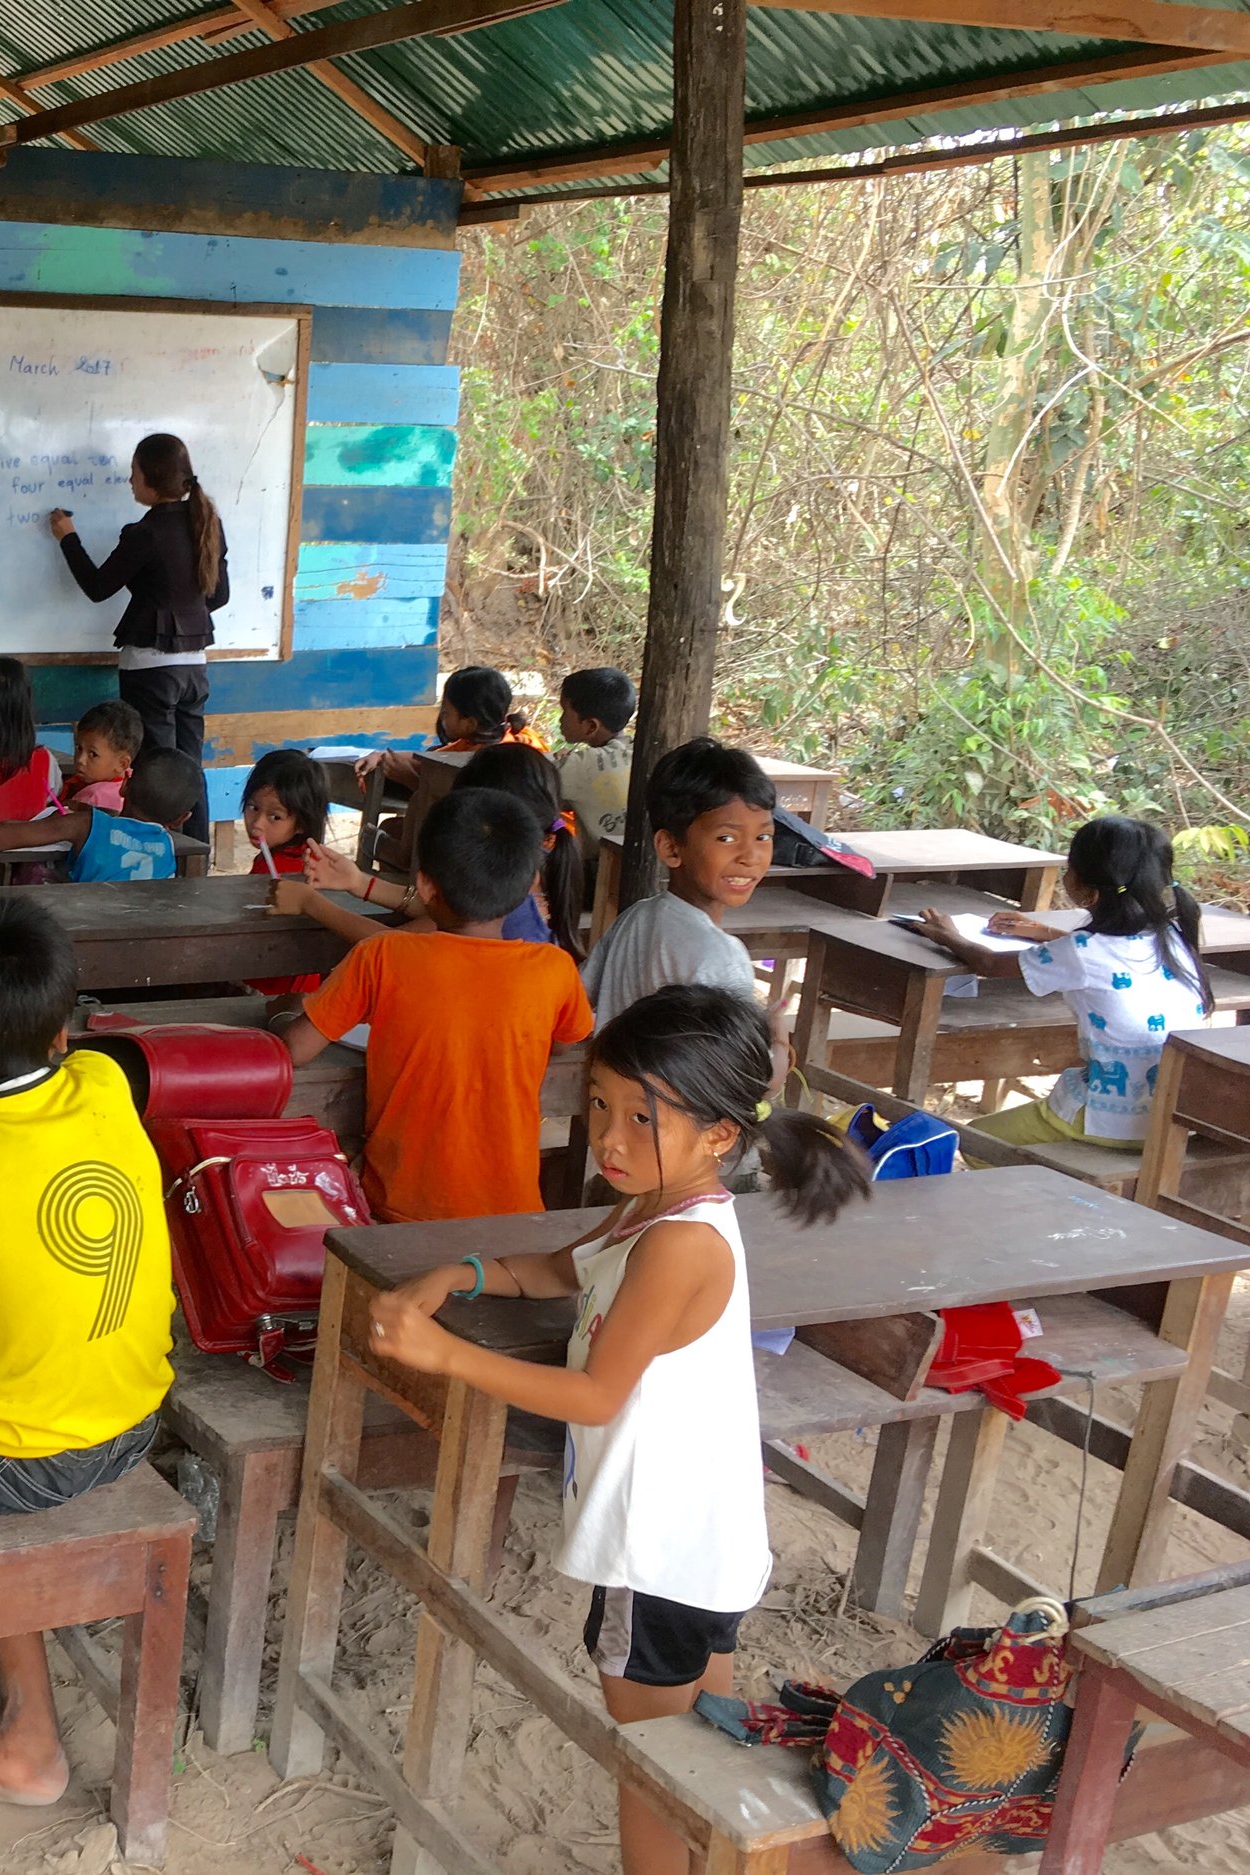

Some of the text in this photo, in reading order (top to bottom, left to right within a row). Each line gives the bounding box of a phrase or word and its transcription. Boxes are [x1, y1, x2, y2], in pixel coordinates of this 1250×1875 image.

[9, 355, 59, 376] March
[75, 355, 111, 376] 2017
[12, 476, 45, 495] four
[58, 472, 94, 493] equal
[7, 507, 40, 527] two
[36, 1160, 144, 1342] 9
